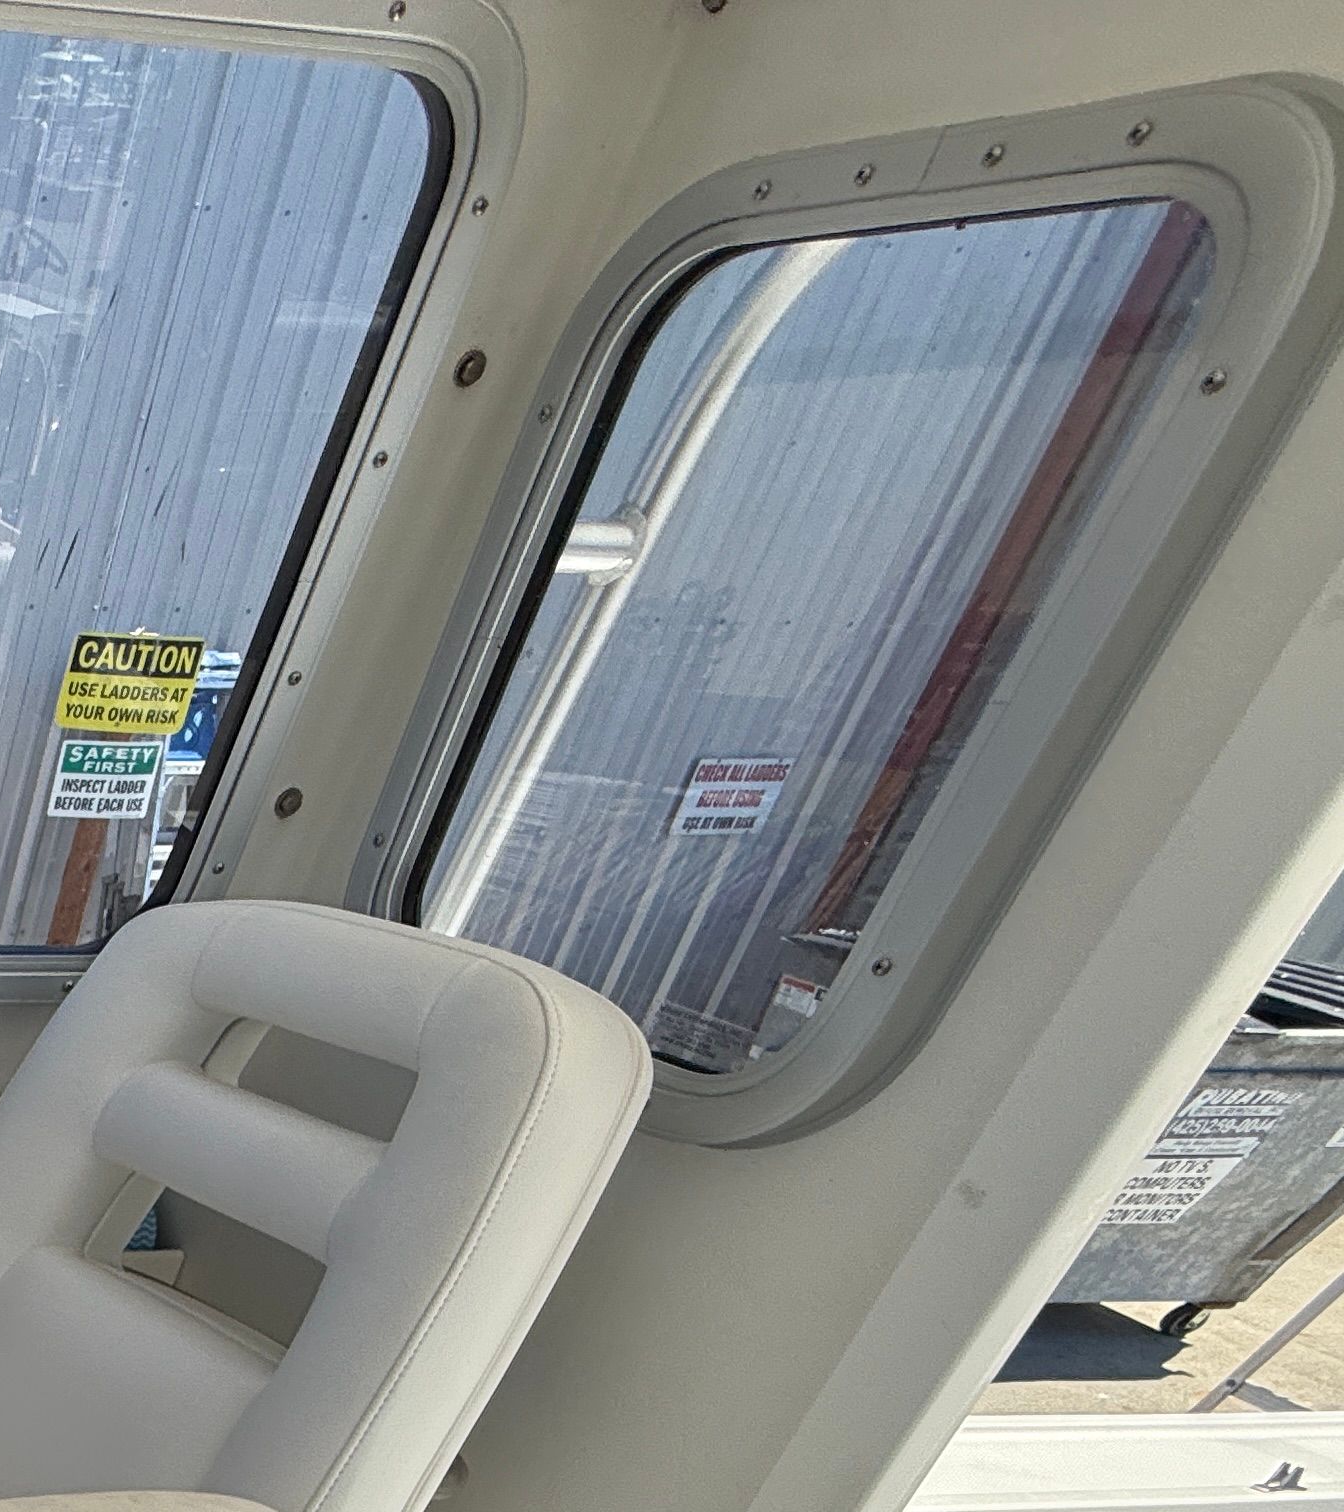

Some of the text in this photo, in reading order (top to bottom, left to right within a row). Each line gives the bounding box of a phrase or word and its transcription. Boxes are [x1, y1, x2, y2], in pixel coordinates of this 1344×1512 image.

[78, 641, 197, 674] CAUTION
[68, 681, 189, 702] USE LADDERS AT
[66, 703, 180, 725] YOUR OWN RISK
[69, 746, 155, 764] SAFETY
[83, 761, 138, 773] FIRST
[61, 779, 147, 794] INSPECT LADDER
[54, 796, 145, 813] BEFORE EACH USE
[1152, 1160, 1184, 1174] NO
[1120, 1192, 1201, 1206] MONITORS
